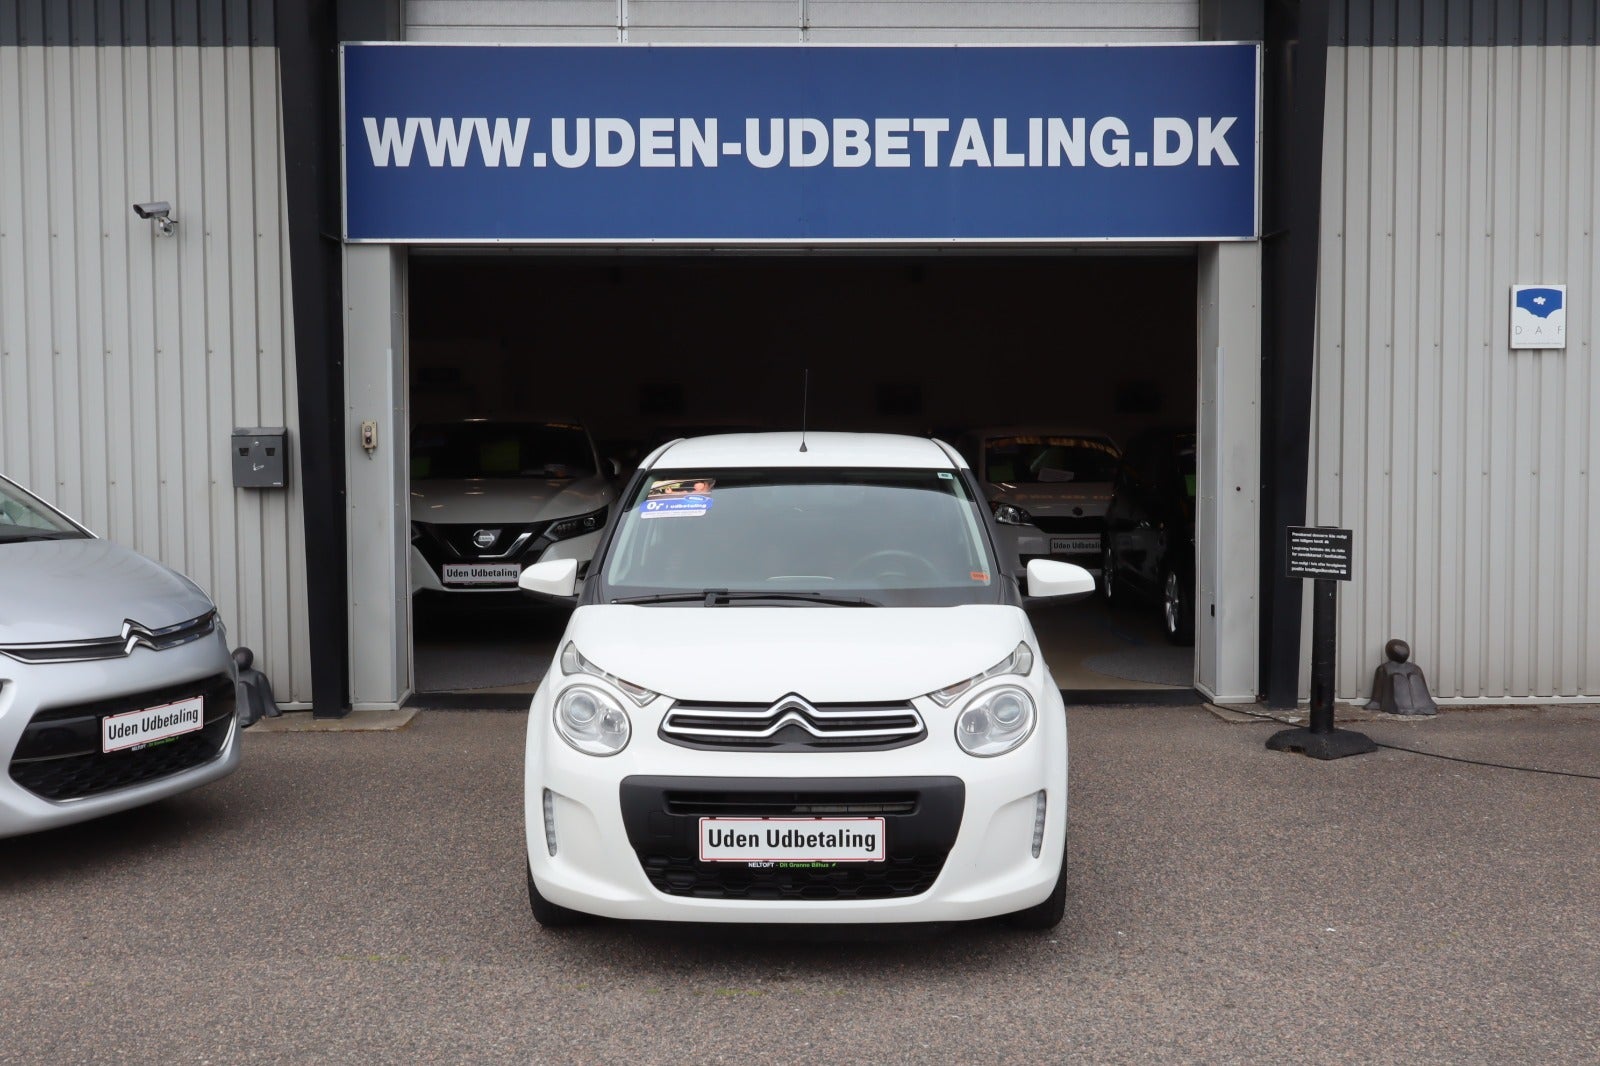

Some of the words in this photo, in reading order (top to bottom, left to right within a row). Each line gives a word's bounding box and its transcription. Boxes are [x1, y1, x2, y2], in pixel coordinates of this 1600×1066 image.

[362, 116, 1240, 169] WWW.UDEN-UDBETALING.DK
[446, 569, 469, 577] Uden
[471, 568, 518, 578] Udbetaling
[108, 722, 138, 740] Uden
[142, 708, 198, 733] Udbetaling
[708, 829, 760, 848] Uden
[766, 829, 876, 852] Udbetaling
